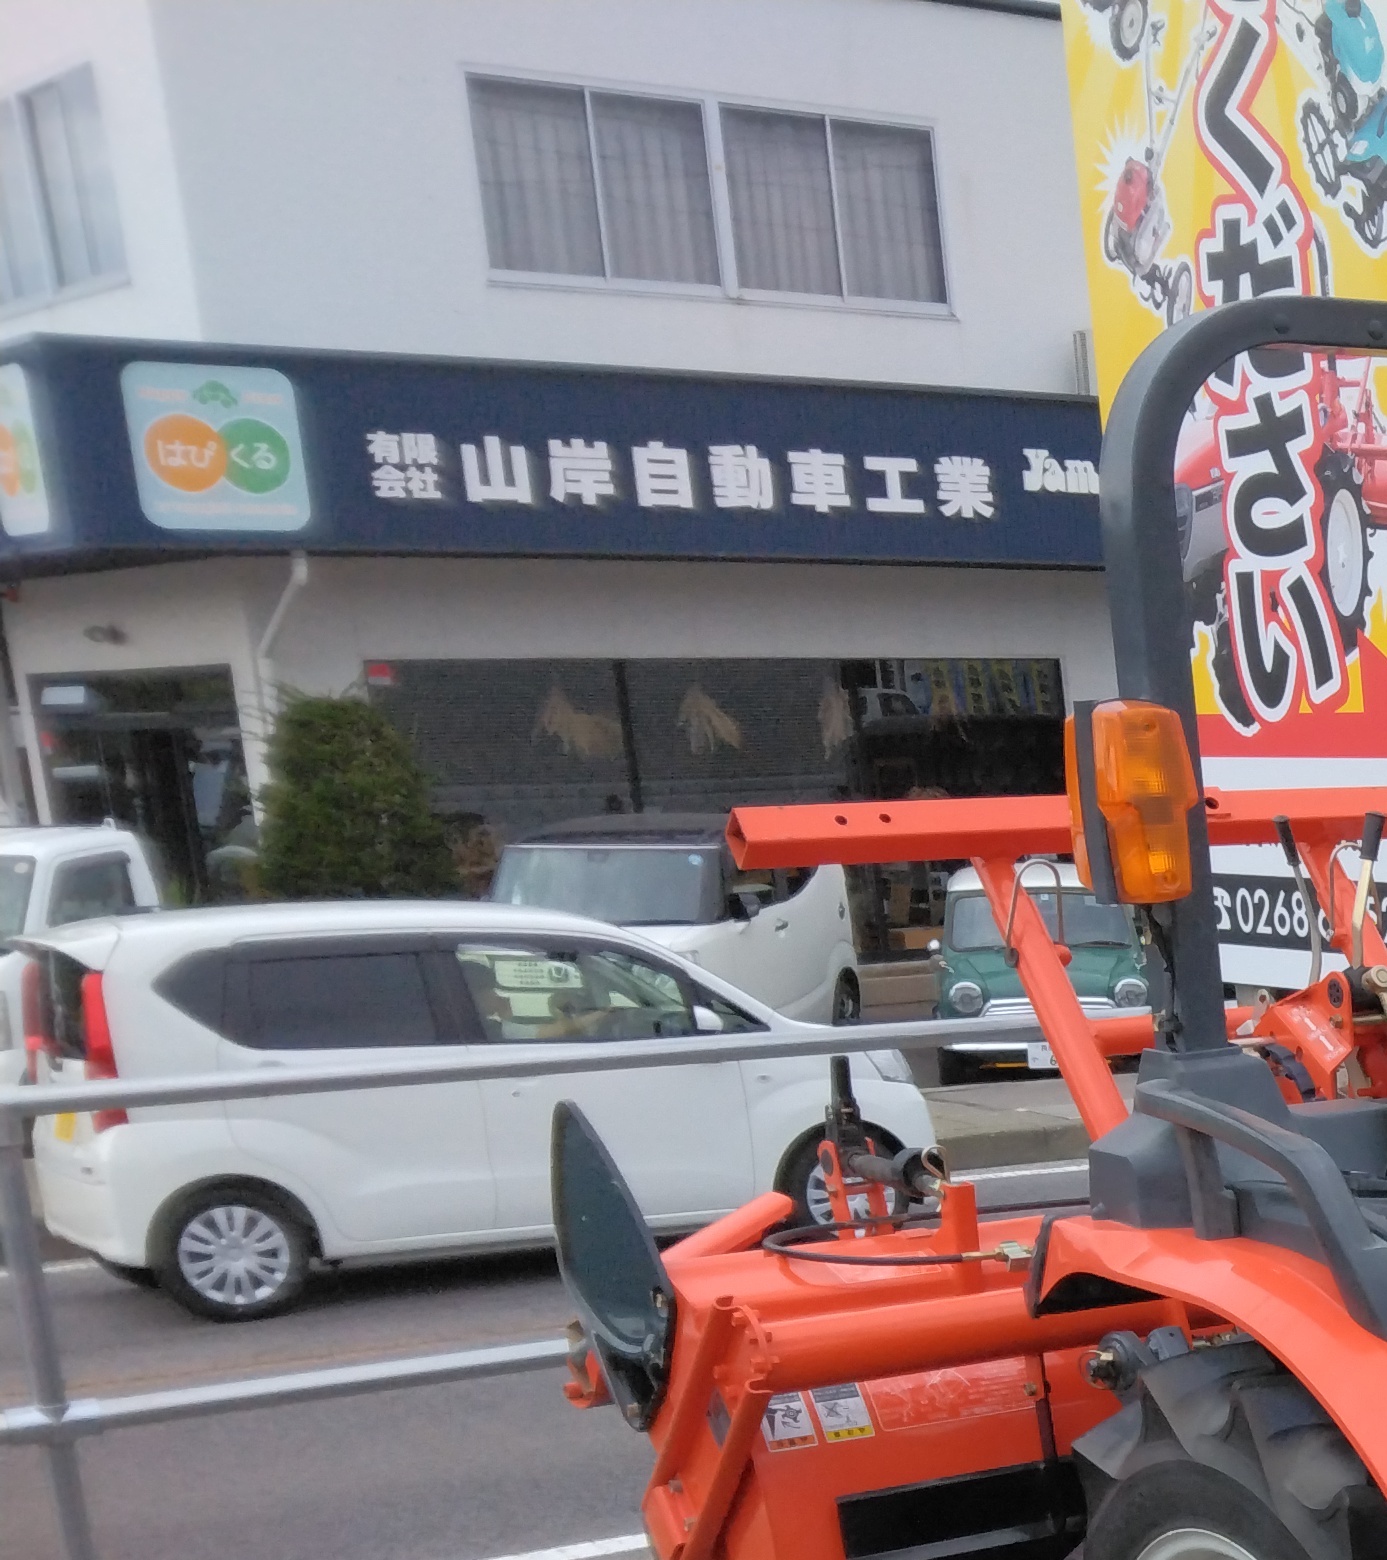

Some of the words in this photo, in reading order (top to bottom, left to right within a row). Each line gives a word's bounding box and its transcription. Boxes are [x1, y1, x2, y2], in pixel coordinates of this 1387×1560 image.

[459, 434, 996, 519] 山岸自動車工業
